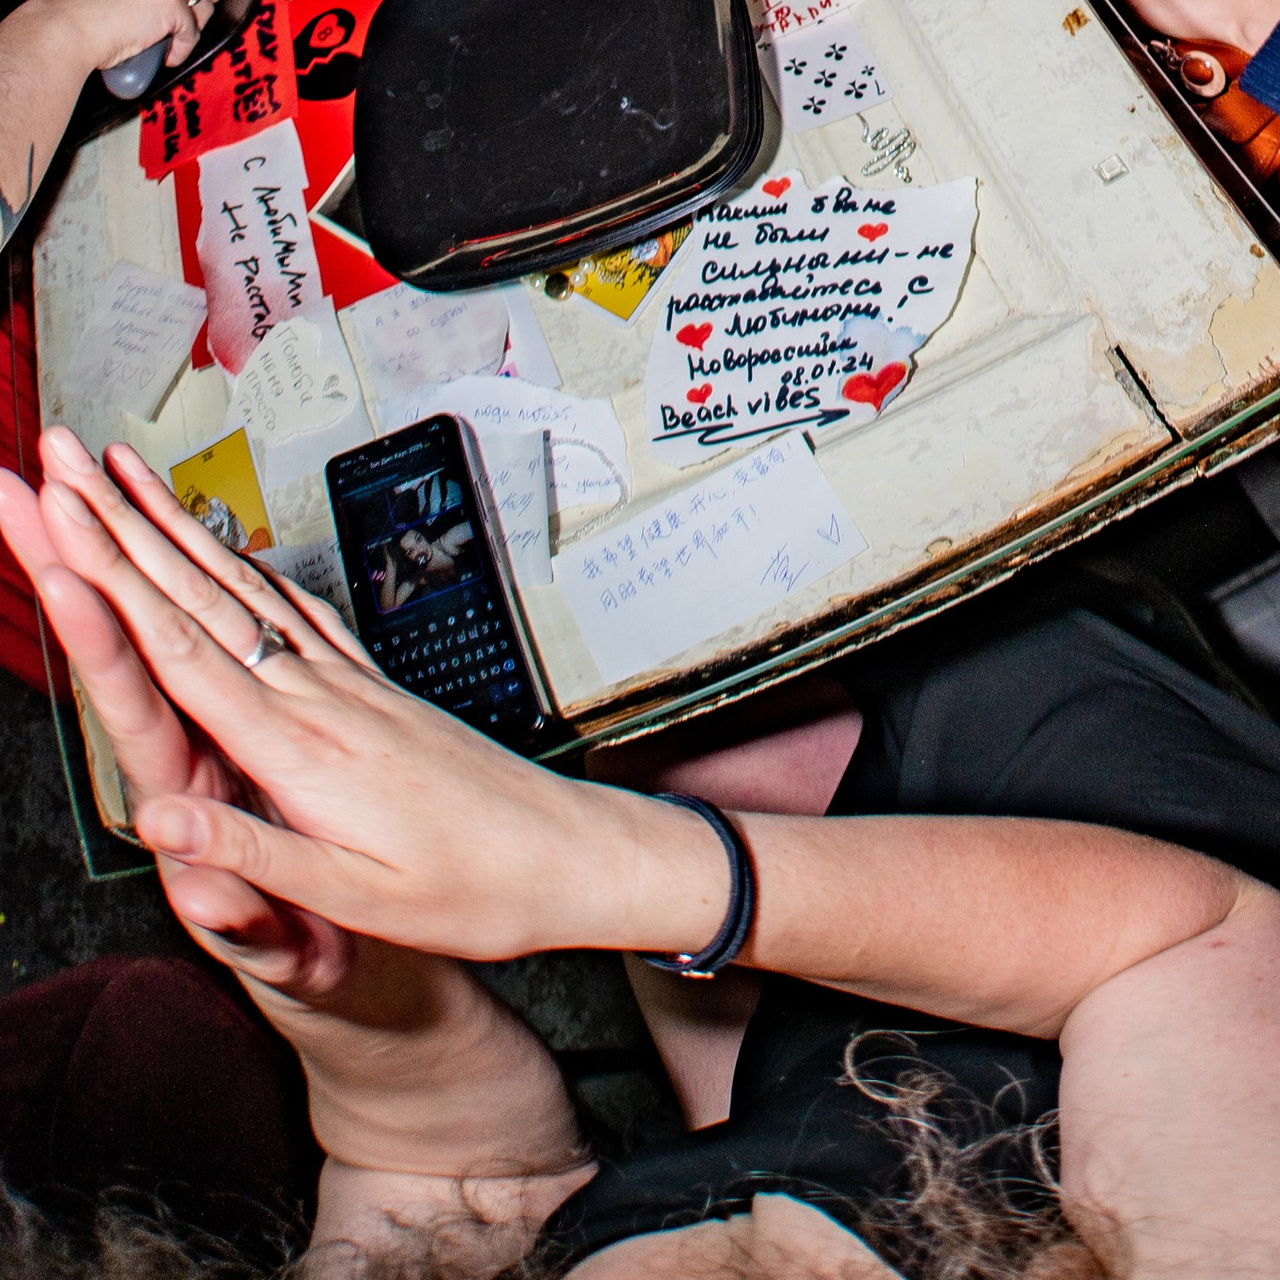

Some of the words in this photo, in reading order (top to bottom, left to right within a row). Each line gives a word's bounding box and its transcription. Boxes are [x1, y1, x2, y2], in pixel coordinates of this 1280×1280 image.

[780, 352, 874, 387] 08.01.24
[661, 394, 739, 430] Beach
[747, 386, 821, 416] vibes
